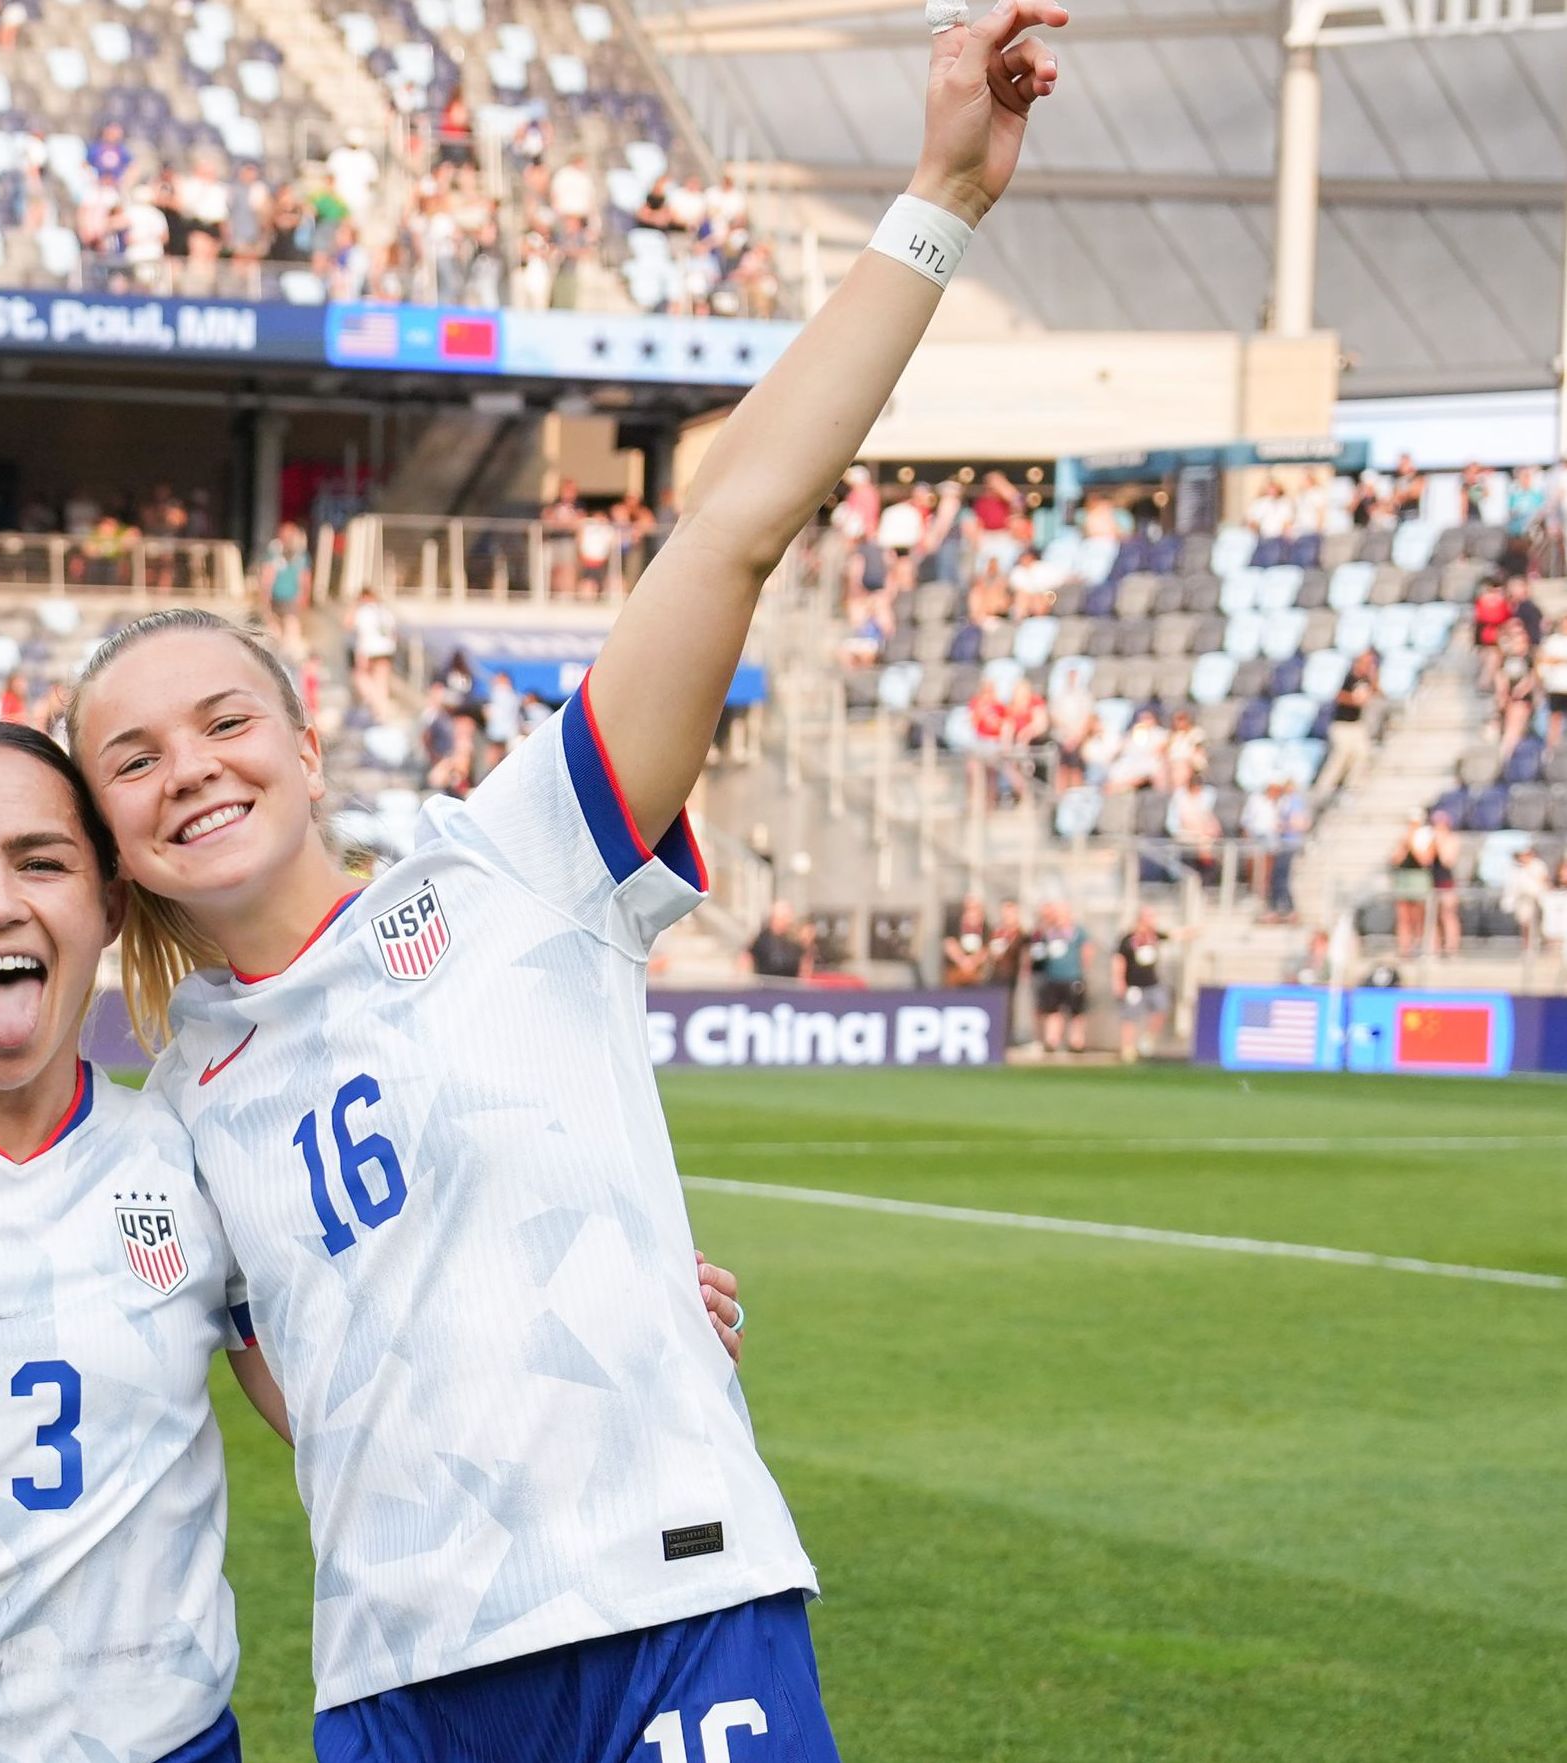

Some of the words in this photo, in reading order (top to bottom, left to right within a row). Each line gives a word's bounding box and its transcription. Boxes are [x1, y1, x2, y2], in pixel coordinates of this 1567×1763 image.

[50, 298, 176, 351] Paul,
[177, 304, 257, 351] MN
[378, 892, 436, 940] USA
[646, 1010, 678, 1066] s
[684, 1003, 887, 1066] China
[895, 1005, 991, 1066] PR
[293, 1073, 408, 1257] 16
[120, 1213, 173, 1247] USA
[11, 1360, 83, 1511] 3
